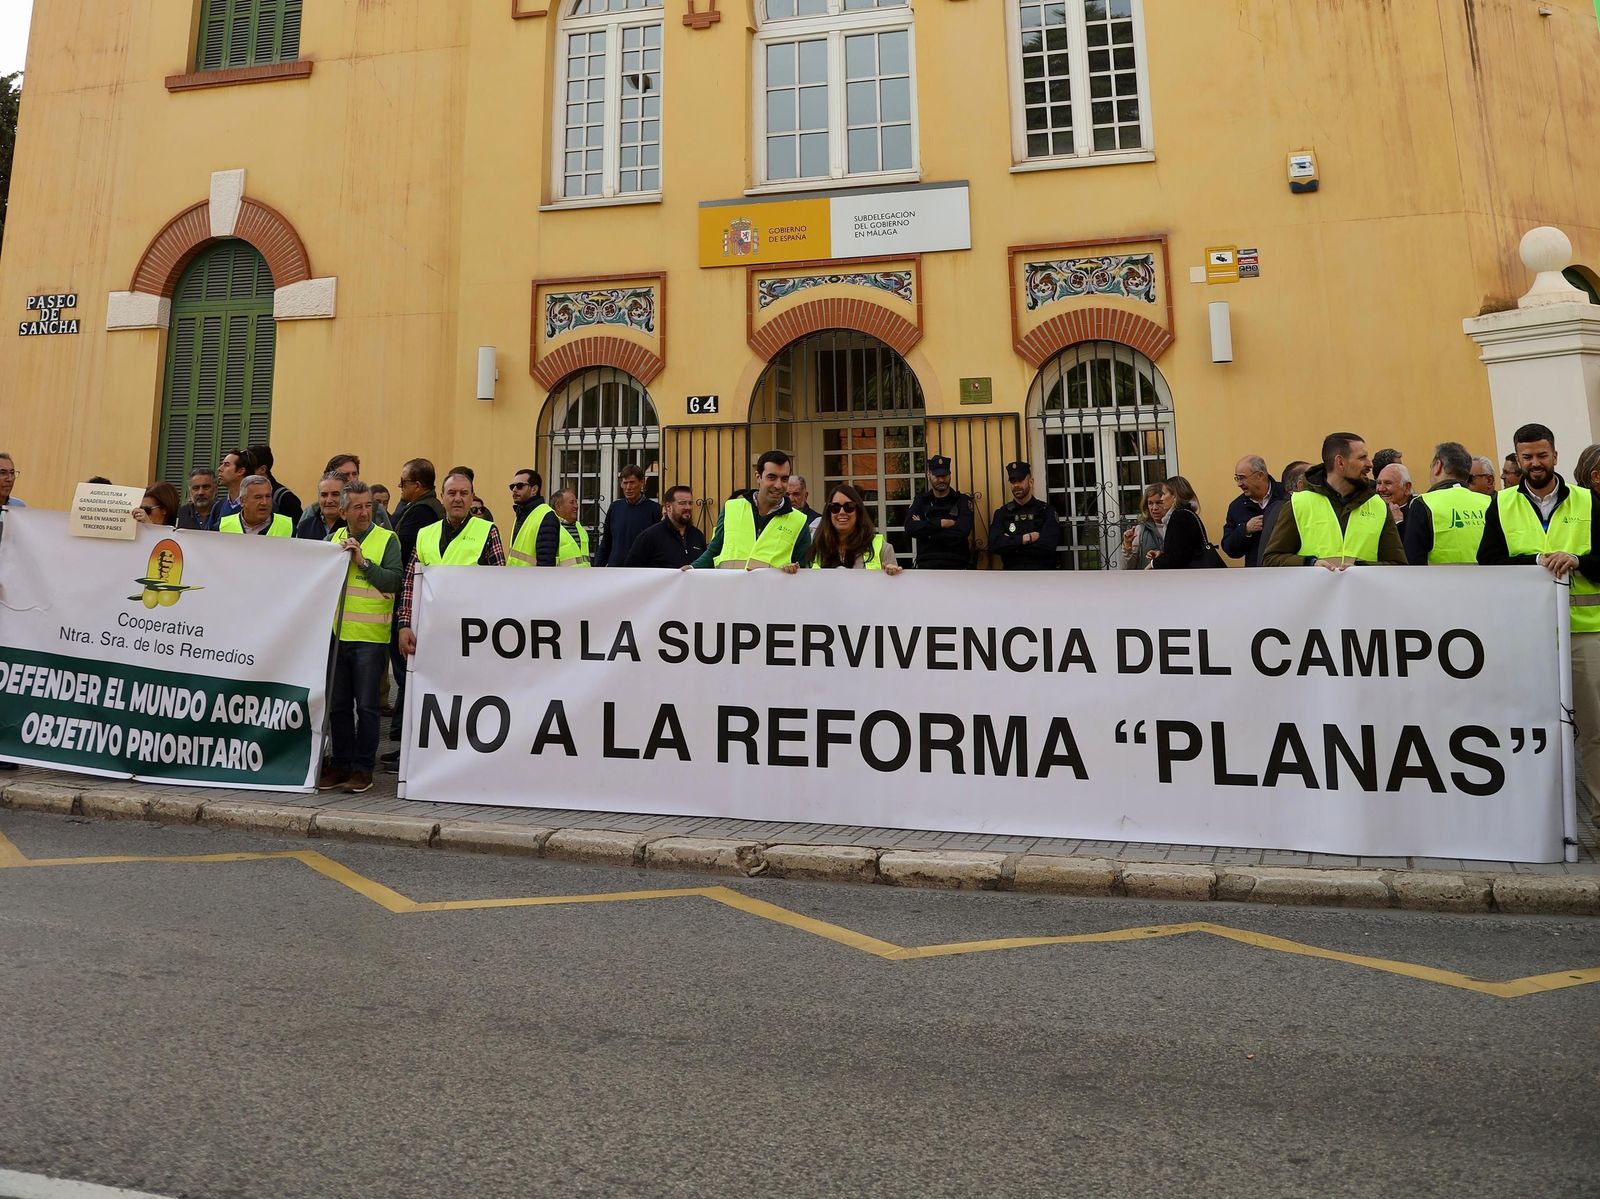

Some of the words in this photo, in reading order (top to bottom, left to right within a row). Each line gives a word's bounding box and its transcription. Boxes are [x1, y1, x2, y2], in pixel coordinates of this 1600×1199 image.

[853, 210, 916, 222] SUBDELEGACIÓN
[768, 225, 807, 234] GOBIERNO
[866, 228, 898, 237] MÁLAGA
[870, 220, 910, 229] GOBIERNO
[780, 233, 807, 241] ESPAÑA
[26, 294, 76, 310] PASEO
[40, 308, 60, 321] DE
[19, 320, 78, 335] SANCHA
[690, 396, 717, 413] 64
[117, 612, 204, 637] Cooperativa
[59, 626, 94, 643] Ntra.
[100, 631, 128, 648] Sra.
[133, 637, 150, 651] de
[154, 639, 174, 655] los
[180, 642, 255, 666] Remedios
[461, 617, 562, 660] POR
[580, 620, 642, 662] LA
[658, 620, 1097, 674] SUPERVIVENCIA
[1116, 628, 1232, 676] DEL
[1250, 627, 1485, 680] CAMPO
[0, 661, 101, 706] DEFENDER
[103, 677, 125, 710] EL
[129, 681, 206, 722] MUNDO
[210, 693, 304, 730] AGRARIO
[21, 712, 123, 756] OBJETIVO
[126, 728, 263, 772] PRIORITARIO
[418, 693, 511, 754] NO
[530, 699, 578, 757] A
[602, 701, 692, 762] LA
[717, 704, 1090, 780] REFORMA
